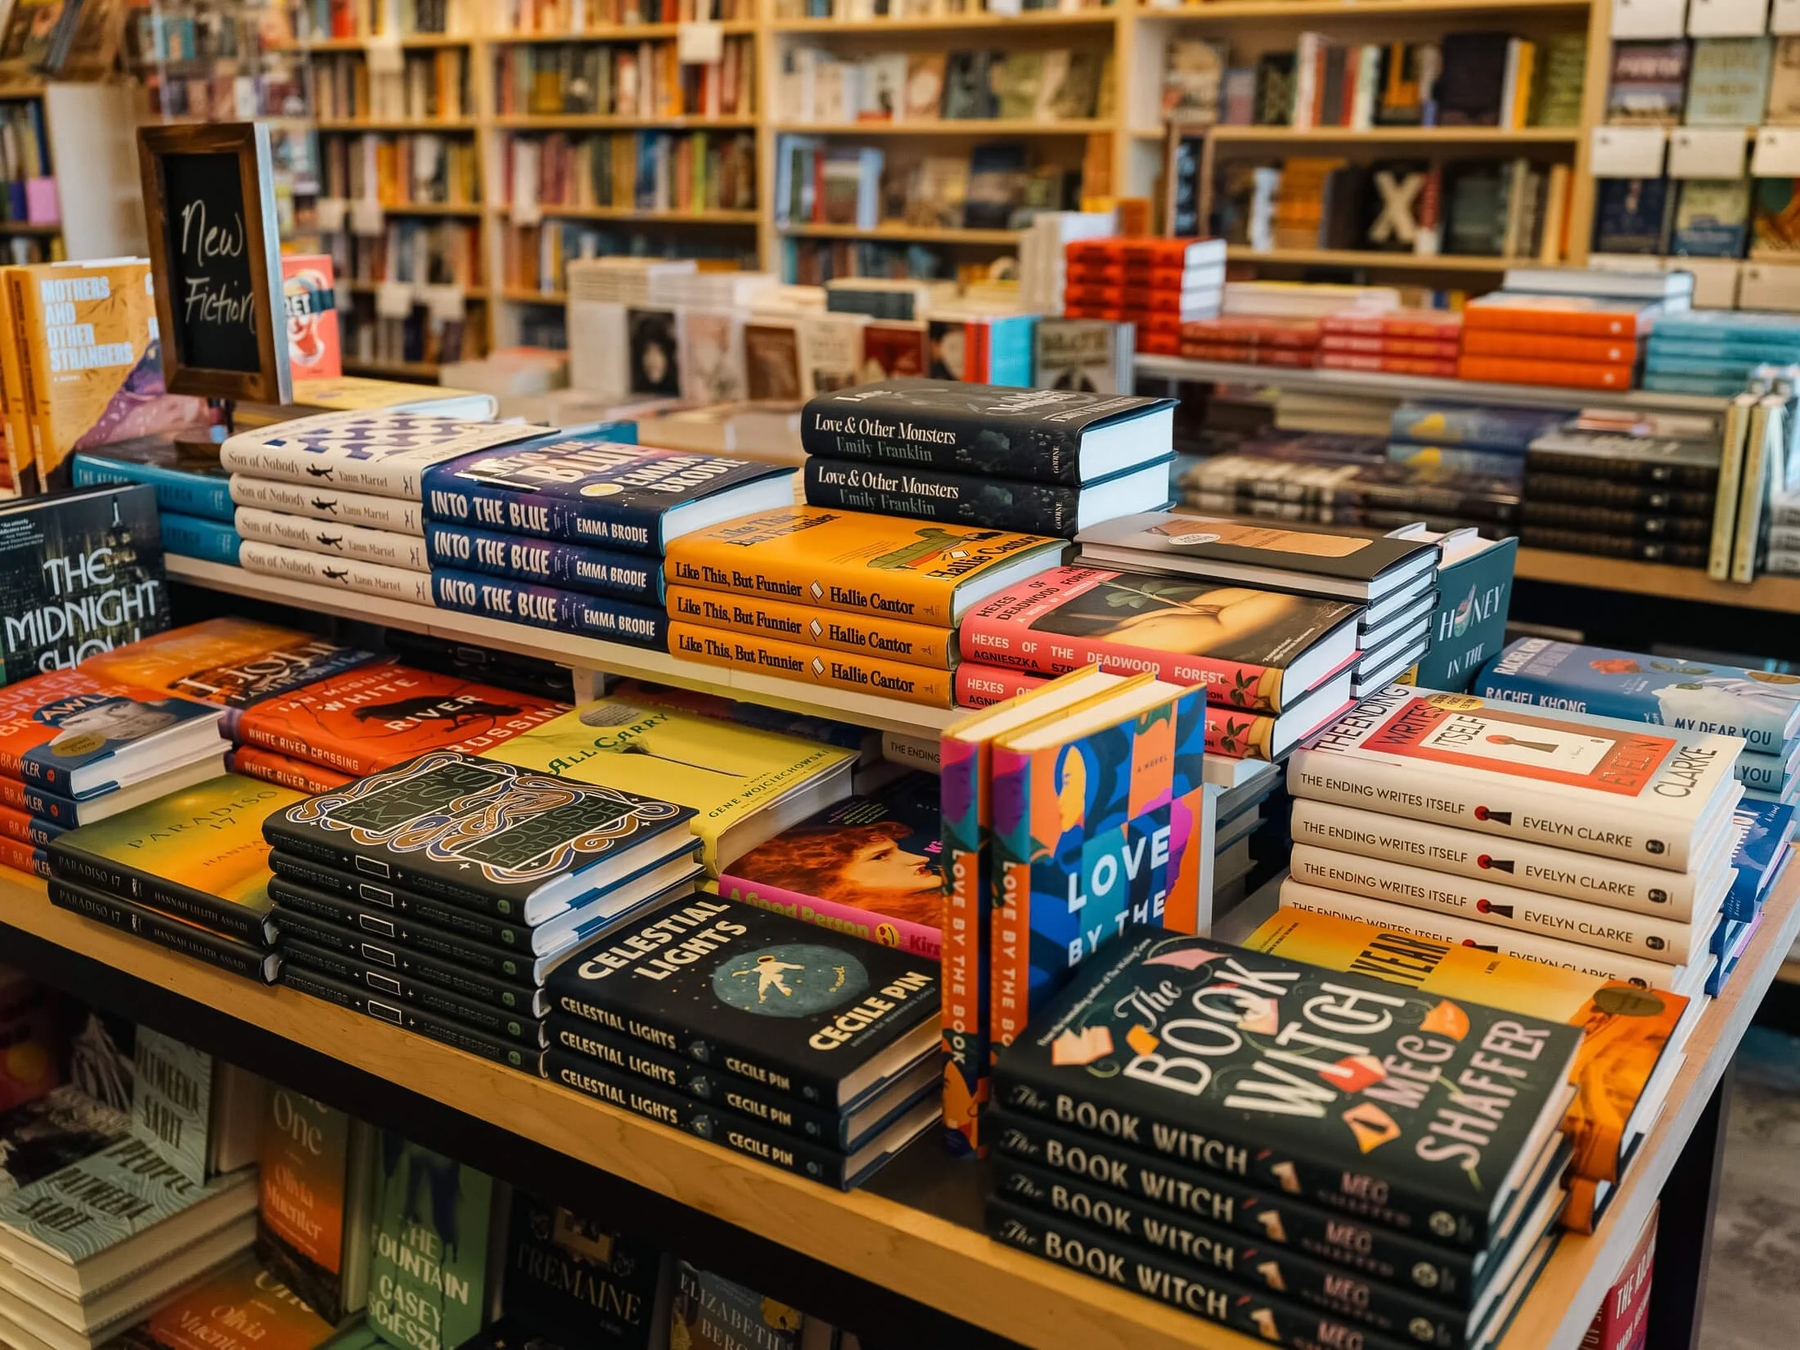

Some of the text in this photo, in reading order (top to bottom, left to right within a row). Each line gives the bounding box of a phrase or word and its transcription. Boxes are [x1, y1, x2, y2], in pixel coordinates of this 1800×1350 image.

[181, 199, 243, 267] New
[41, 276, 110, 301] MOTHERS
[45, 302, 76, 327] AND
[185, 277, 256, 335] Fiction
[47, 324, 94, 347] OTHER
[51, 342, 133, 372] STRANGERS
[815, 414, 957, 445] Love & Other Monsters
[836, 437, 933, 462] Emily Franklin
[228, 452, 389, 488] Son of Nobody Yann Martel
[613, 456, 703, 487] EMMA
[647, 458, 749, 494] BRODIE
[431, 490, 649, 544] INTO THE BLUE EMMA BRODIE
[43, 548, 115, 596] THE
[434, 531, 648, 589] INTO THE BLUE EMMA BRODIE
[925, 533, 1046, 582] Hallie Cantor
[675, 562, 915, 616] Like This, But Funnier Hallie Cantor
[976, 580, 1048, 618] HEXES OF
[996, 587, 1060, 621] DEADWOOD
[5, 580, 159, 653] MIDNIGHT
[677, 596, 913, 655] Like This, But Funnier Hallie Cantor
[972, 633, 1009, 649] HEXES
[1022, 642, 1038, 653] OF
[1051, 646, 1074, 660] THE
[1087, 651, 1160, 674] DEADWOOD
[1174, 666, 1226, 684] FOREST
[974, 650, 1039, 669] AGNIESZKA
[1447, 654, 1463, 680] IN
[1464, 642, 1486, 671] THE
[278, 695, 317, 713] IAN
[317, 678, 420, 714] WHITE
[384, 693, 484, 732] RIVER
[1314, 719, 1362, 752] THE
[1342, 687, 1410, 736] ENDING
[1486, 686, 1533, 705] RACHEL
[1540, 694, 1587, 714] KHONG
[248, 727, 360, 771] WHITE RIVER CROSSING
[548, 747, 598, 777] ALL
[594, 712, 670, 749] CARRY
[1375, 704, 1445, 745] WRITES
[1433, 716, 1487, 748] ITSELF
[1675, 718, 1772, 746] MY DEAR YOU
[1, 752, 41, 778] BRAWLER
[890, 741, 940, 763] THE ENDING
[1653, 746, 1718, 798] CLARKE
[4, 786, 45, 813] BRAWLER
[708, 798, 742, 819] GENE
[744, 749, 830, 798] WOJCIECHOWSKI
[1301, 772, 1634, 849] THE ENDING WRITES ITSELF EVELYN CLARKE
[127, 790, 279, 850] PARADISO
[210, 817, 236, 830] 17
[462, 796, 598, 861] LOUISE
[497, 803, 632, 866] ERDRICH
[58, 856, 108, 883] PARADISO
[111, 874, 121, 887] 17
[154, 891, 188, 911] HANNAH
[1068, 823, 1172, 914] LOVE
[1303, 820, 1636, 898] THE ENDING WRITES ITSELF EVELYN CLARKE
[577, 900, 731, 981] CELESTIAL
[801, 905, 870, 939] Person
[1069, 890, 1167, 967] BY THE
[633, 920, 748, 982] LIGHTS
[952, 849, 966, 1065] LOVE BY THE BOOK
[808, 990, 890, 1051] CECILE
[880, 971, 934, 1000] PIN
[1113, 980, 1183, 1033] The
[1124, 959, 1300, 1096] BOOK
[561, 996, 790, 1091] CELESTIAL LIGHTS CECILE PIN
[1224, 982, 1406, 1119] WITCH
[1364, 1035, 1456, 1109] MEG
[1416, 1021, 1552, 1170] SHAFFER
[273, 1090, 323, 1155] One
[1056, 1095, 1140, 1142] BOOK
[1153, 1124, 1248, 1176] WITCH
[379, 1274, 442, 1332] CASEY
[517, 1242, 642, 1326] TREMAINE
[680, 1272, 780, 1350] ELIZABETH
